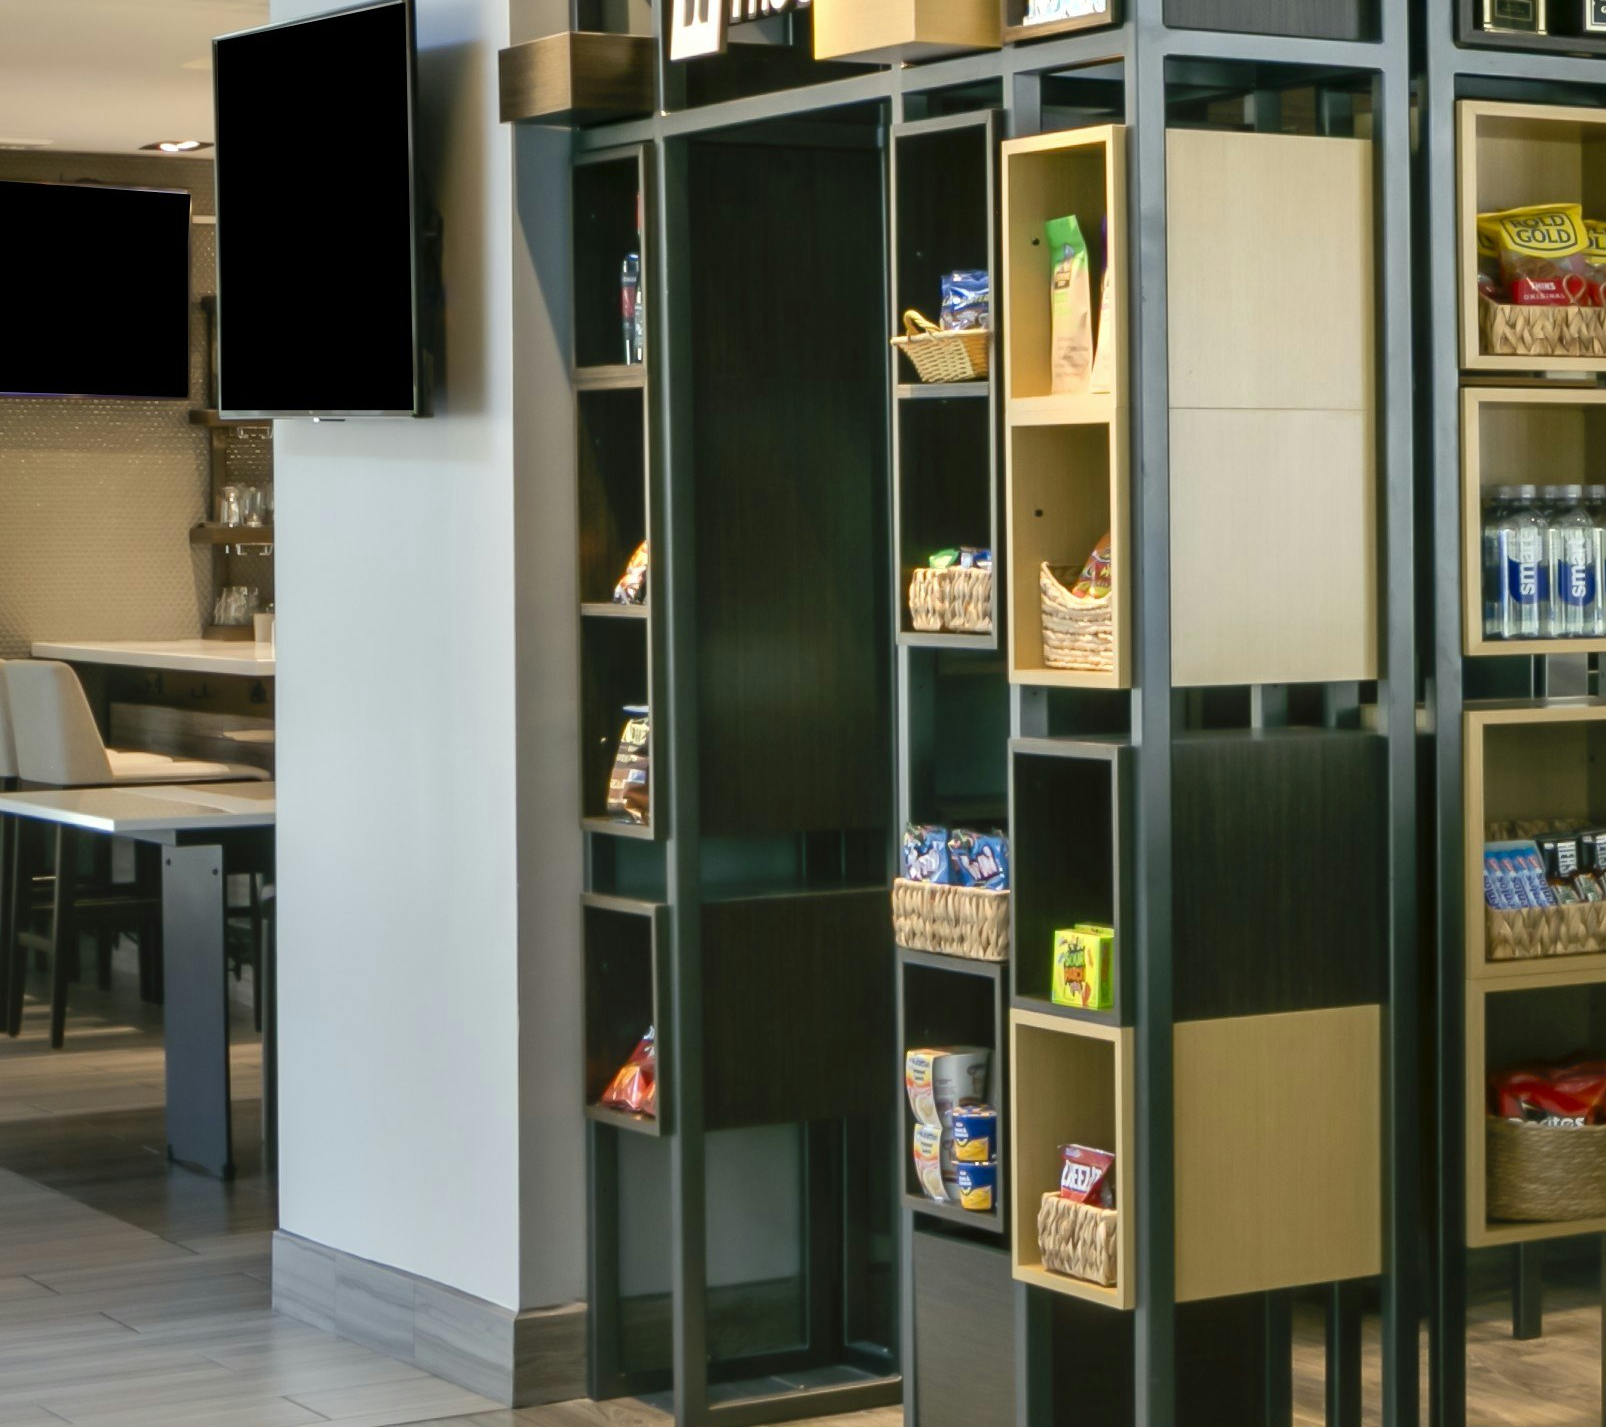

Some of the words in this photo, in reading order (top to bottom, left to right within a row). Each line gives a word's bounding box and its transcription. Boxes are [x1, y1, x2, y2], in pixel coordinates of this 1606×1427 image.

[1509, 214, 1565, 228] ROLD
[1516, 228, 1571, 243] GOLD
[1519, 535, 1536, 595] smart
[1566, 538, 1586, 597] smart
